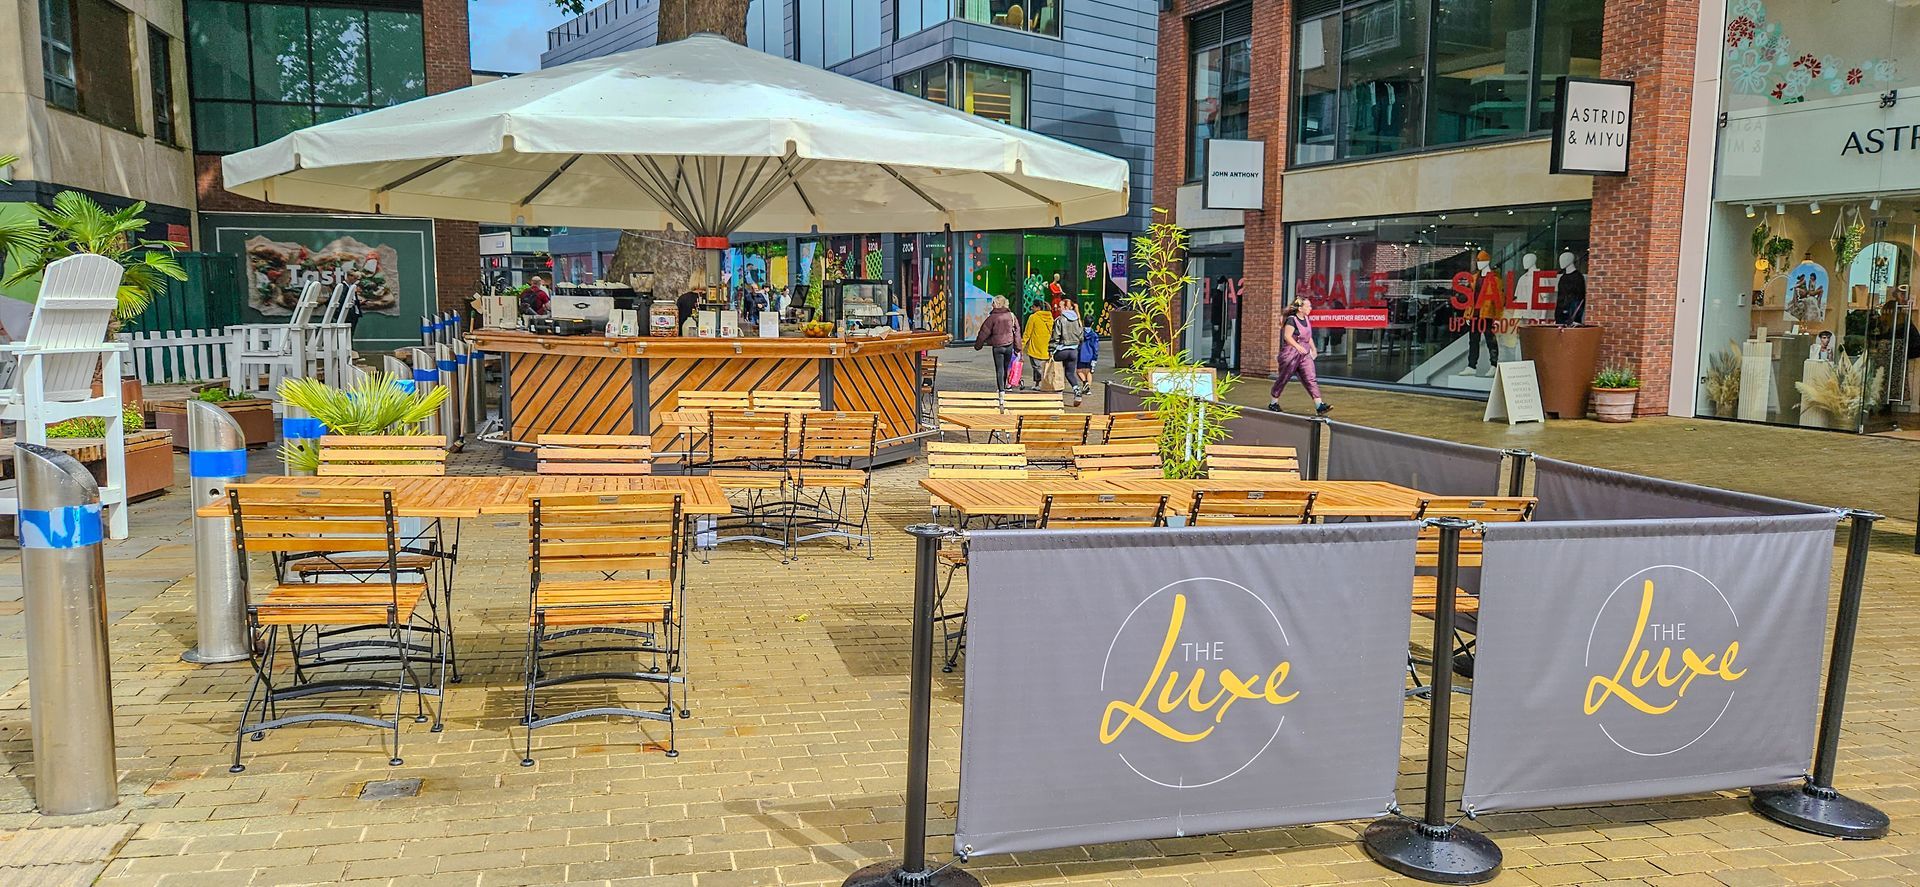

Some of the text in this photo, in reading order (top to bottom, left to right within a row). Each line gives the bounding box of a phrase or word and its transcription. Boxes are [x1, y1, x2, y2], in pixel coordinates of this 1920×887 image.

[1569, 107, 1626, 125] ASTRID
[1568, 130, 1625, 147] & MIYU
[286, 264, 347, 288] Tast
[1310, 271, 1390, 308] SALE
[1450, 270, 1560, 311] SALE
[1448, 316, 1466, 333] UP
[1469, 316, 1487, 333] TO
[1491, 317, 1520, 335] 50%
[1651, 621, 1686, 641] THE
[1181, 640, 1225, 662] THE
[1583, 579, 1748, 716] Luxe
[1098, 593, 1301, 745] Luxe
